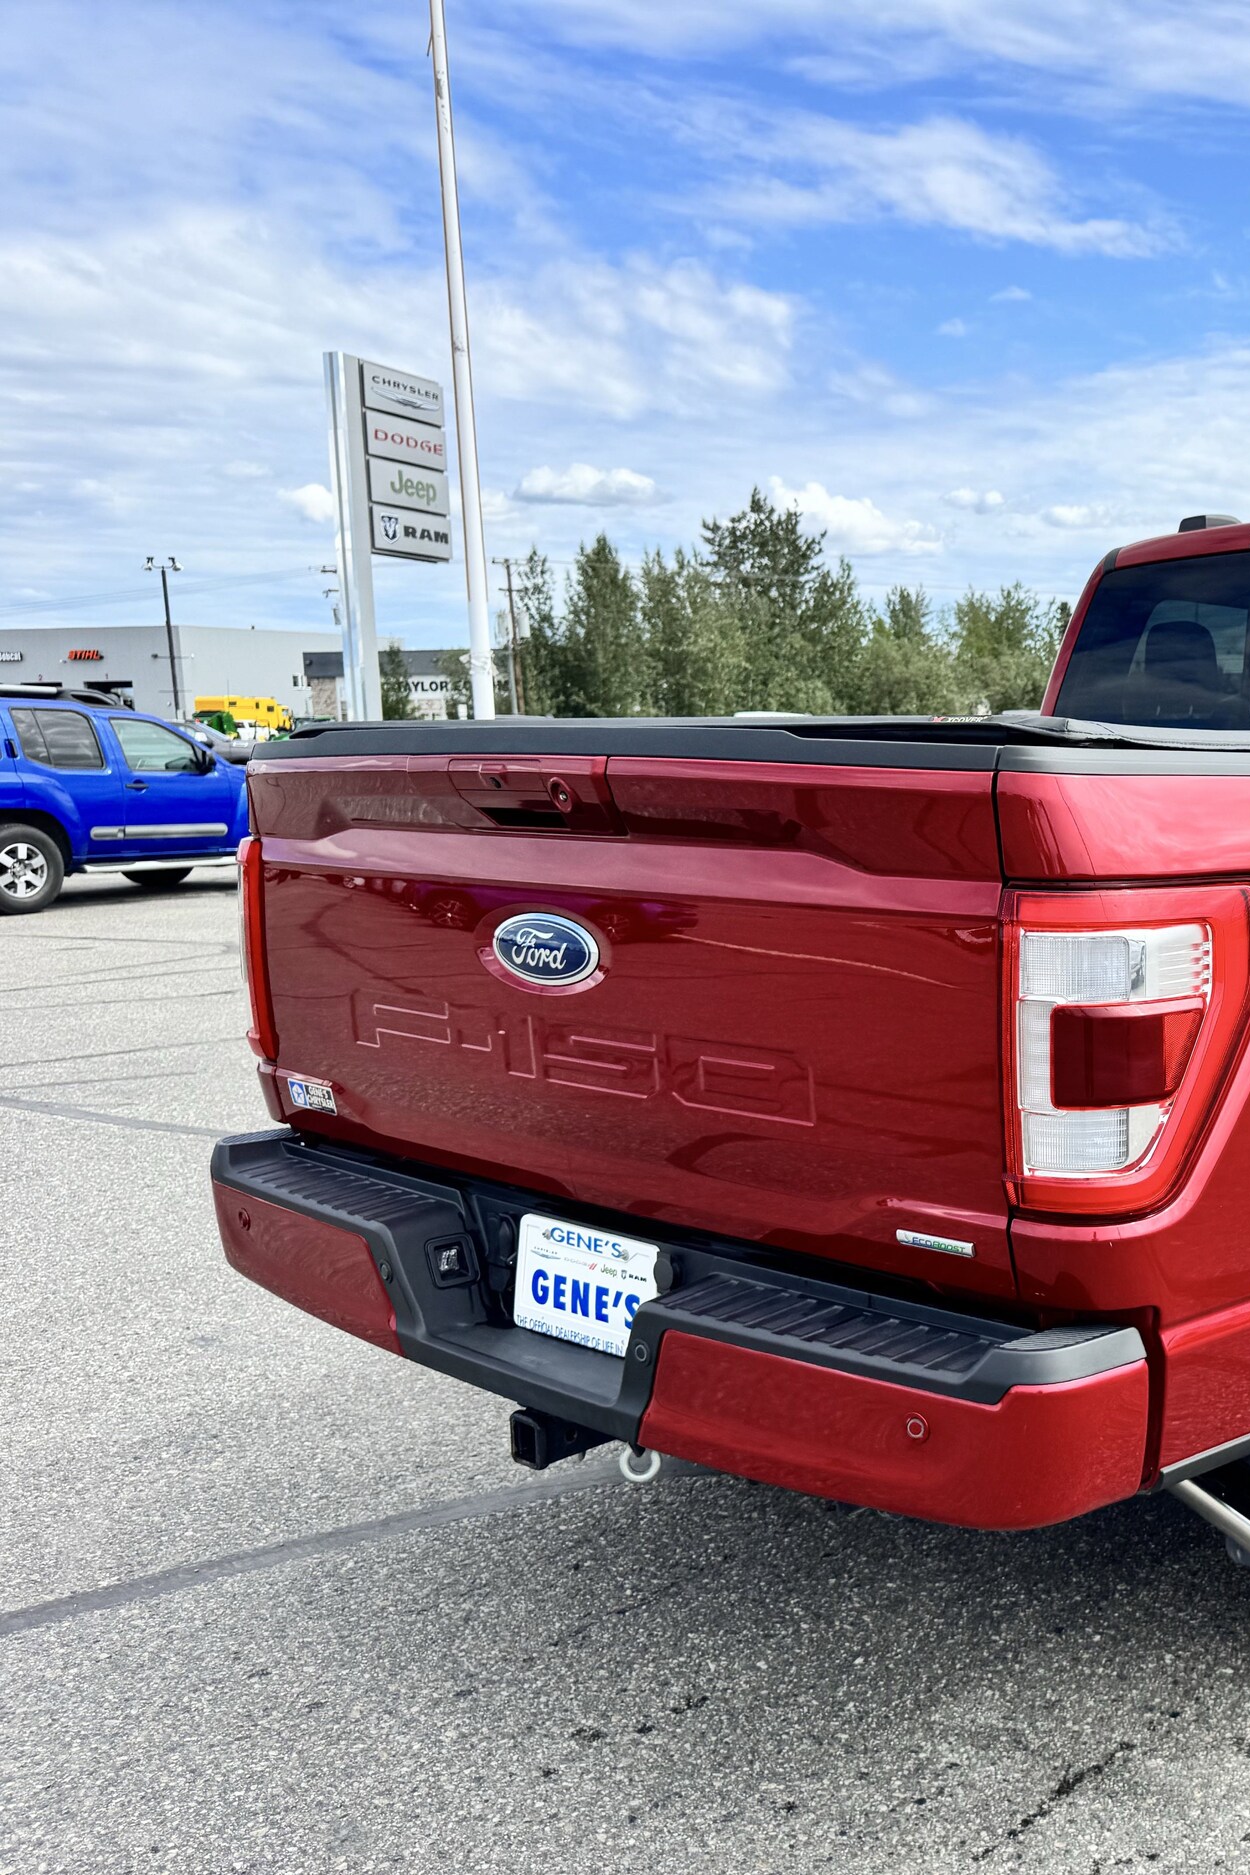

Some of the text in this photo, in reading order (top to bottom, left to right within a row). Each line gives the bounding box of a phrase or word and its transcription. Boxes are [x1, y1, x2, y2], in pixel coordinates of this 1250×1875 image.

[372, 375, 439, 401] CHRYSLER
[374, 428, 443, 456] DODGE
[390, 470, 437, 505] Jeep
[403, 525, 449, 544] RAM
[68, 649, 100, 660] STIHL
[511, 927, 568, 970] Ford
[550, 1227, 623, 1258] GENE'S
[911, 1236, 966, 1253] ECOBOOST
[600, 1264, 618, 1278] Jeep
[628, 1273, 647, 1282] RAM
[531, 1268, 640, 1330] GENE'S
[517, 1314, 527, 1327] THE
[529, 1318, 553, 1335] OFFICIAL
[592, 1336, 601, 1349] OF
